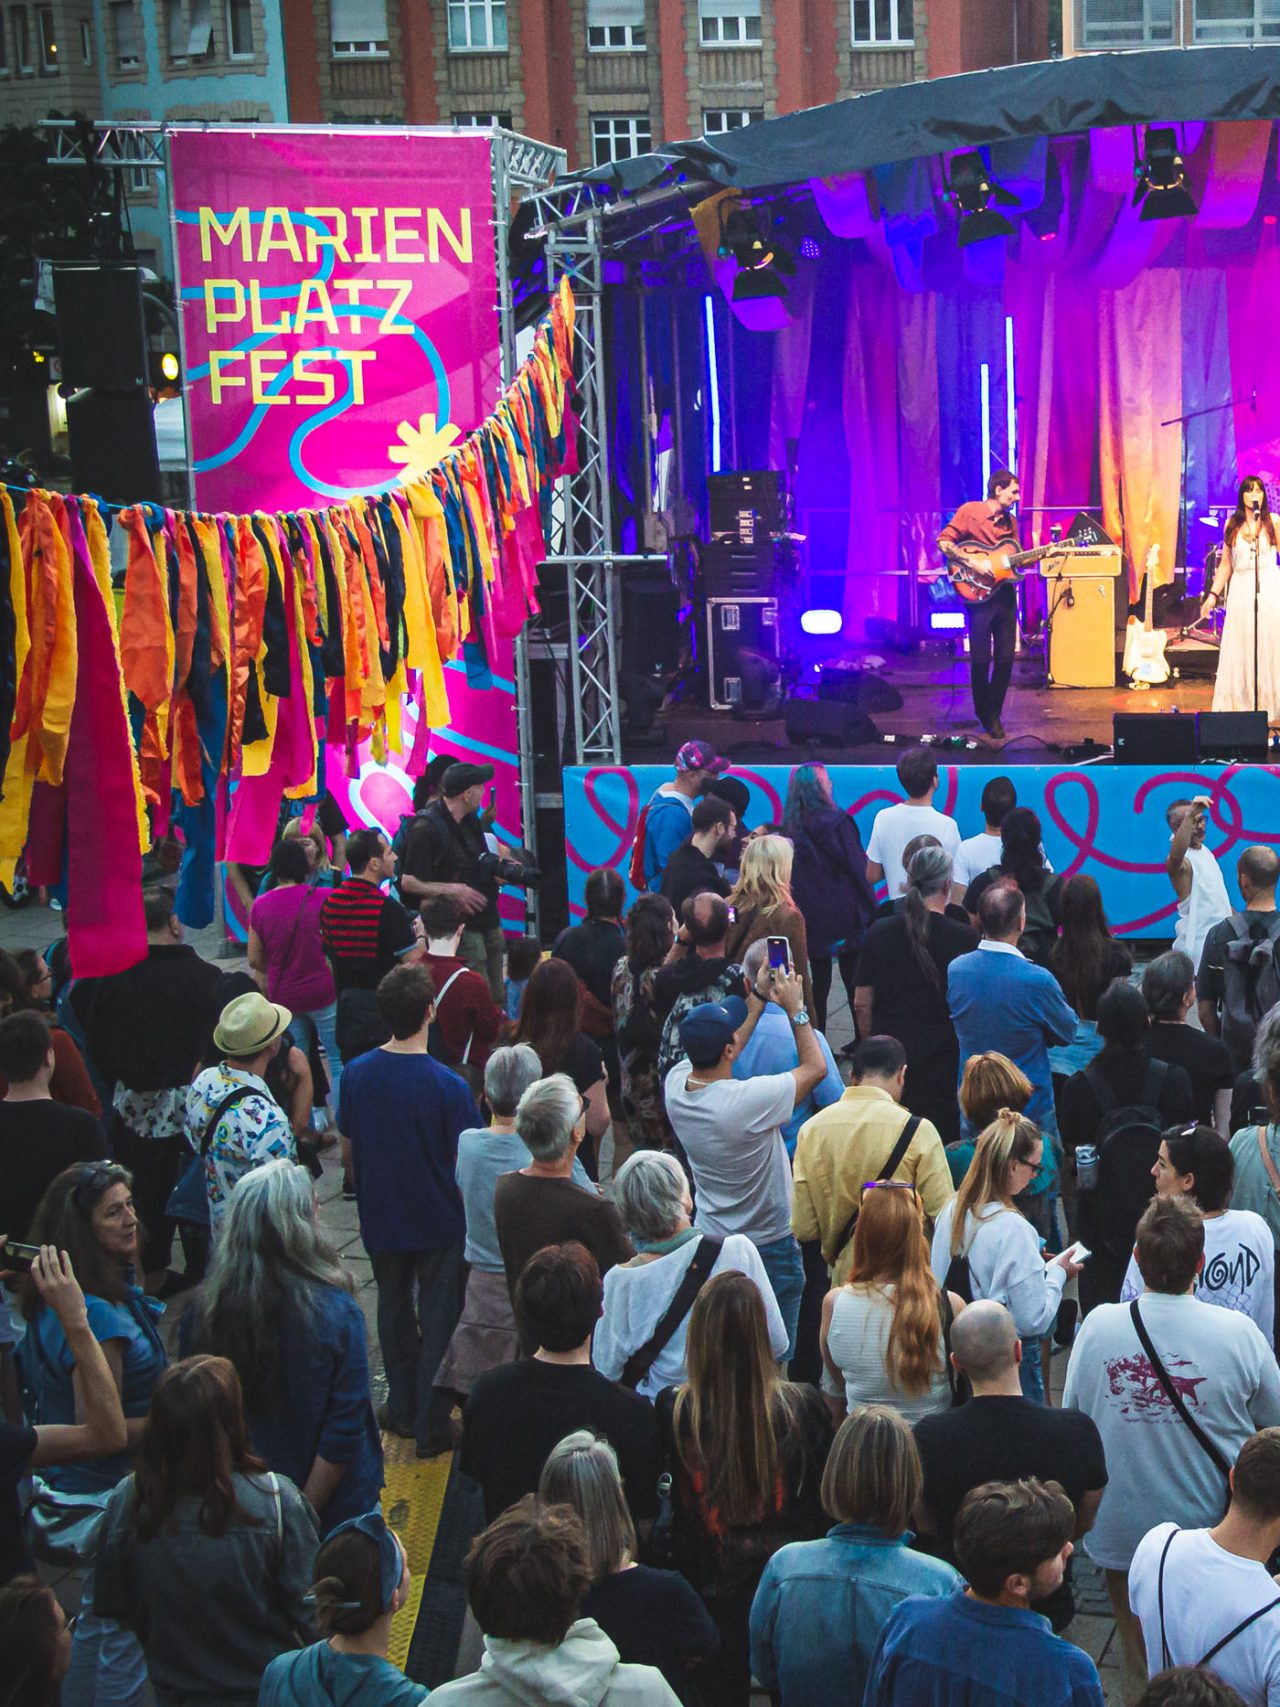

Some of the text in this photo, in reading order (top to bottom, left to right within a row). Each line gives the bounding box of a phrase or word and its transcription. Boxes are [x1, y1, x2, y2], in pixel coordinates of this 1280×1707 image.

[199, 206, 473, 263] MARIEN
[204, 279, 415, 334] PLATZ
[209, 350, 376, 405] FEST
[1199, 1243, 1260, 1295] OND
